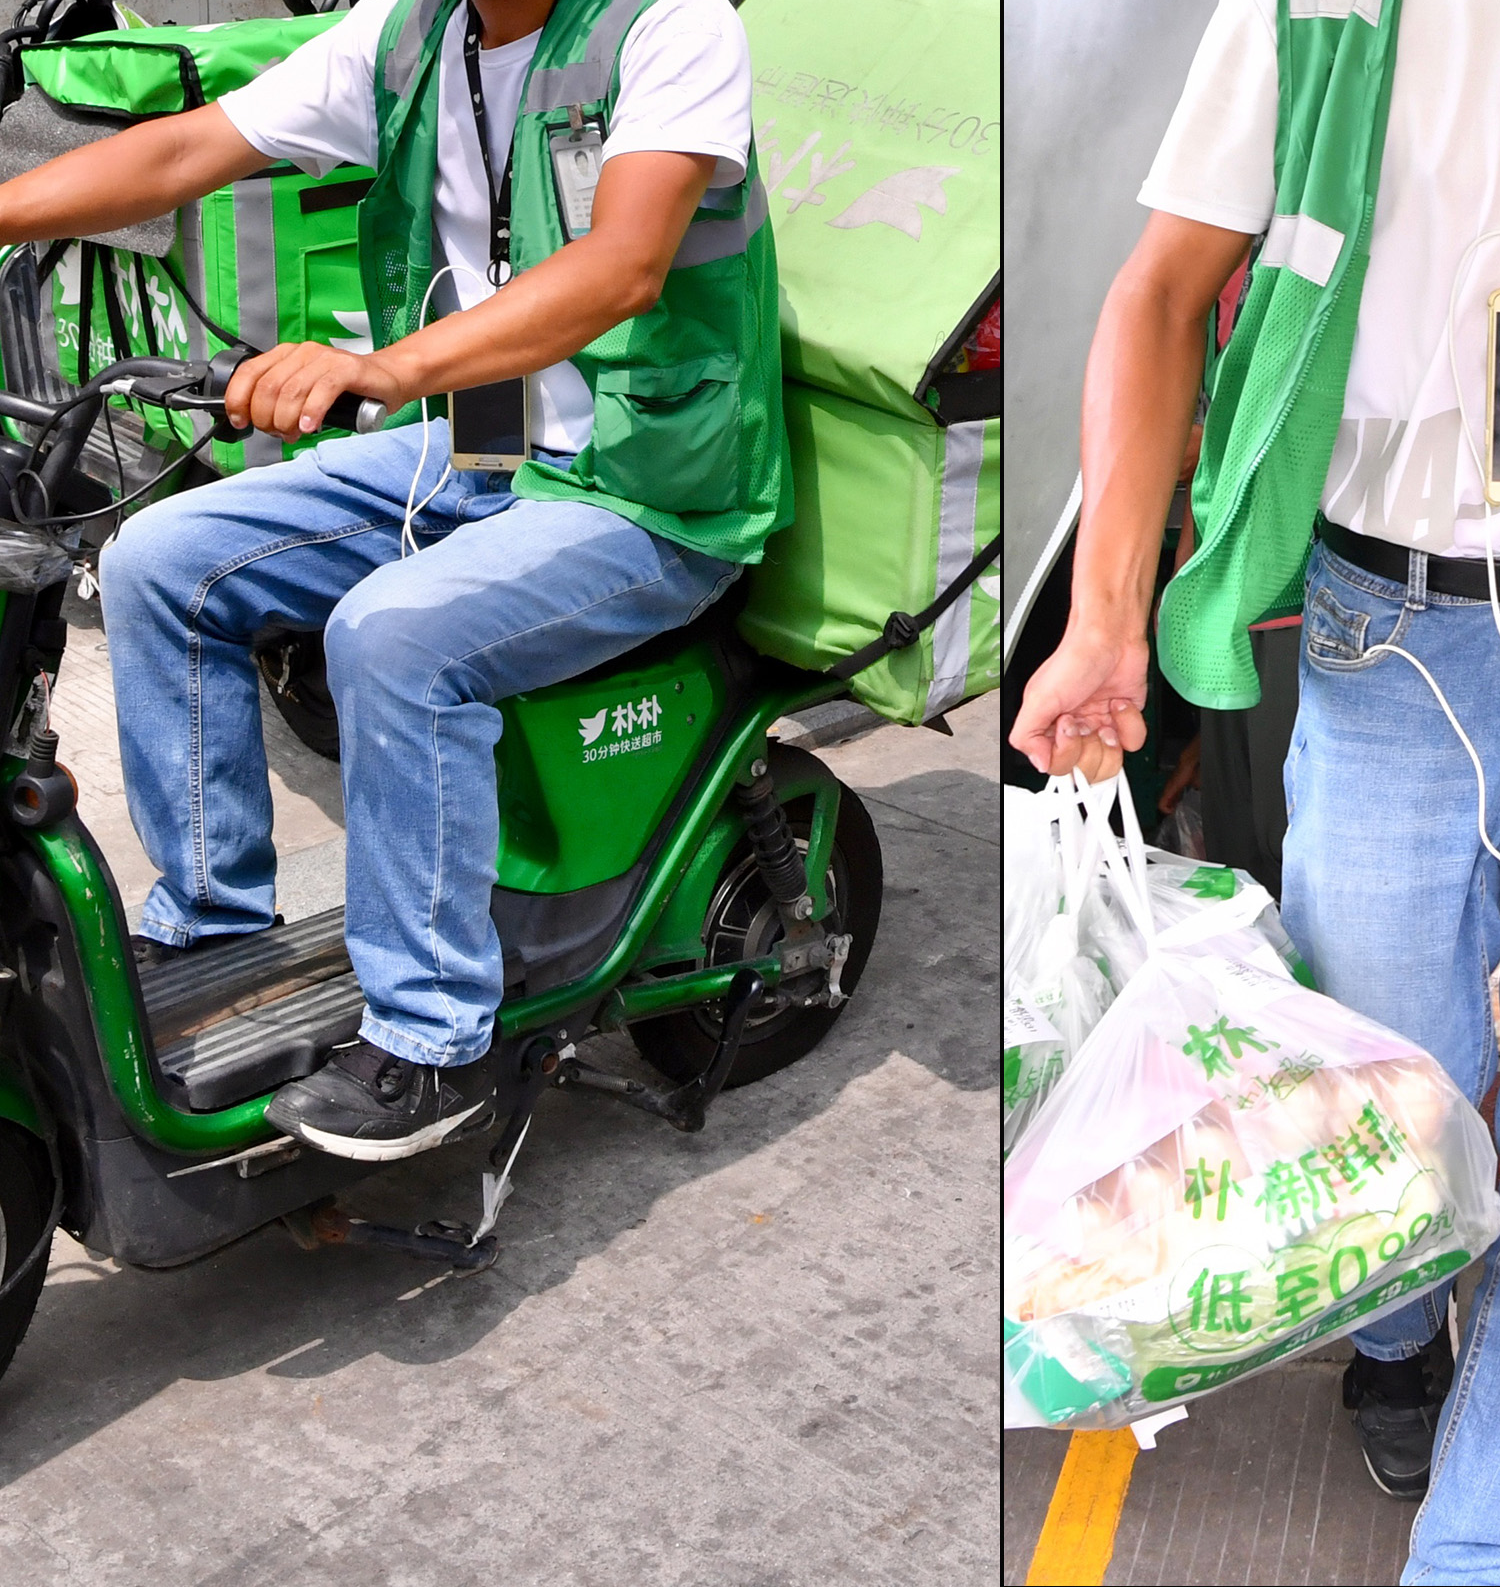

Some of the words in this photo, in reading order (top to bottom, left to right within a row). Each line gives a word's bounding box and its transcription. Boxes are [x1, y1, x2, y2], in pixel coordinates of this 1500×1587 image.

[611, 694, 663, 737] 朴朴
[582, 729, 662, 764] 30分钟快送超市
